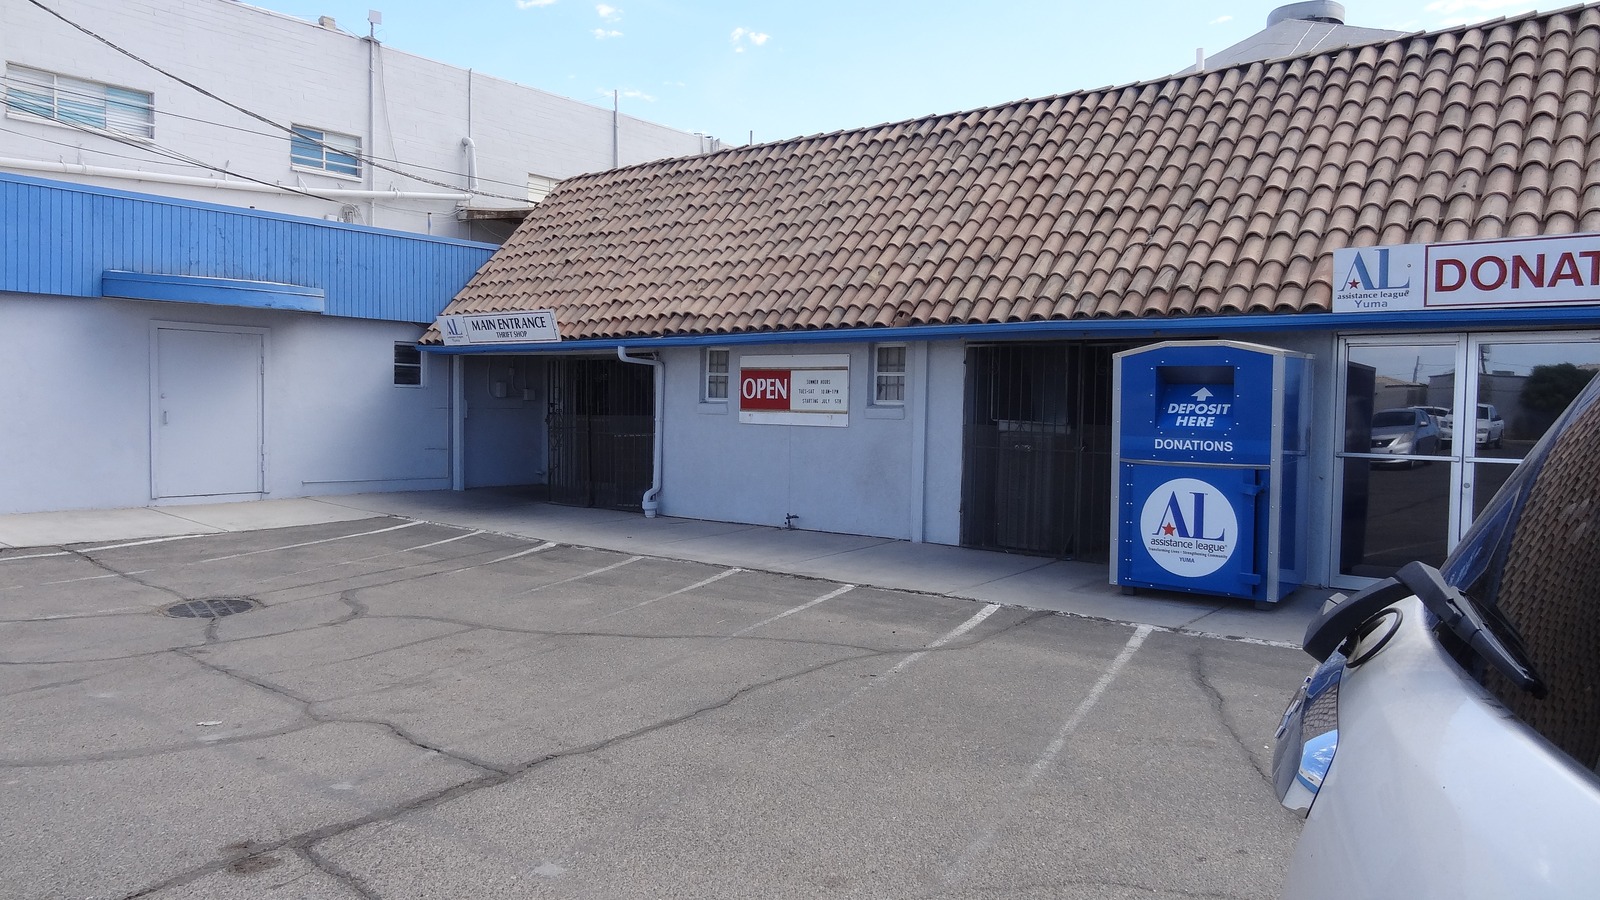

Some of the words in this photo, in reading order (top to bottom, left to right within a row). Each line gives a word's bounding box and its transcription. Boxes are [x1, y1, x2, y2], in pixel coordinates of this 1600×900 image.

[1337, 249, 1410, 291] AL
[1337, 292, 1378, 300] assistance
[1354, 300, 1388, 308] Yuma
[447, 318, 463, 335] AL
[471, 319, 497, 331] MAIN
[497, 316, 547, 330] ENTRANCE
[496, 331, 513, 339] THRIFT
[514, 330, 528, 338] SHOP
[742, 378, 788, 399] OPEN
[1167, 403, 1231, 414] DEPOSIT
[1175, 416, 1216, 427] HERE
[1154, 438, 1234, 452] DONATIONS
[1152, 490, 1226, 541] AL
[1150, 537, 1193, 549] assistance
